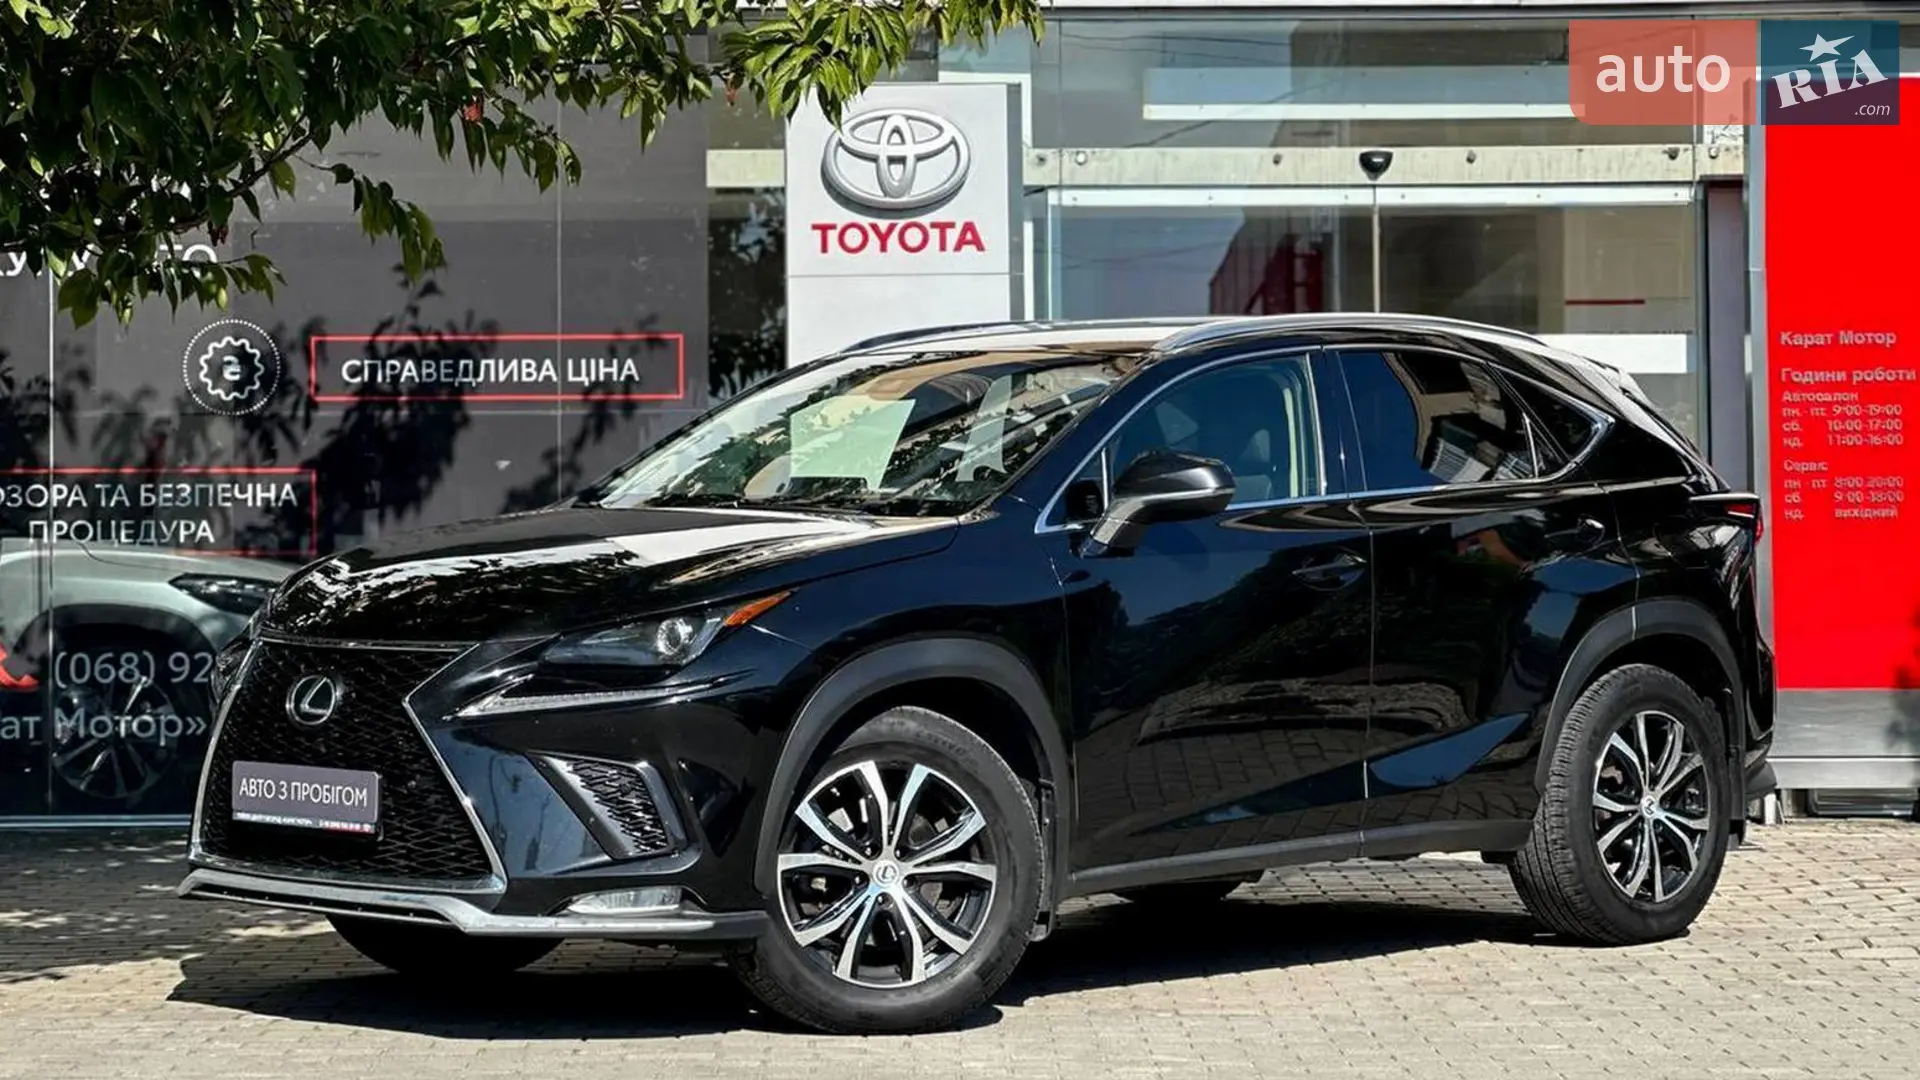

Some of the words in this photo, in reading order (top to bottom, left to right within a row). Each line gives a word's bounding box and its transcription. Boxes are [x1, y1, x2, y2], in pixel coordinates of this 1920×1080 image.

[811, 221, 986, 254] TOYOTA
[1780, 331, 1833, 348] Карат
[1839, 330, 1897, 347] Мотор
[341, 358, 558, 387] СПРАВЕДЛИВА
[566, 357, 640, 387] ЦІНА
[1781, 367, 1848, 384] Години
[1852, 366, 1917, 384] роботи
[1782, 390, 1859, 402] Автосалон
[0, 483, 88, 508] ЗОРА
[95, 483, 131, 508] ТА
[140, 483, 298, 508] БЕЗПЕЧНА
[29, 519, 216, 548] ПРОЦЕДУРА
[54, 651, 156, 688] (068)
[168, 651, 213, 683] 92
[54, 707, 208, 747] Мотор»
[239, 777, 276, 799] АВТО
[291, 781, 368, 808] ПРОБІГОМ
